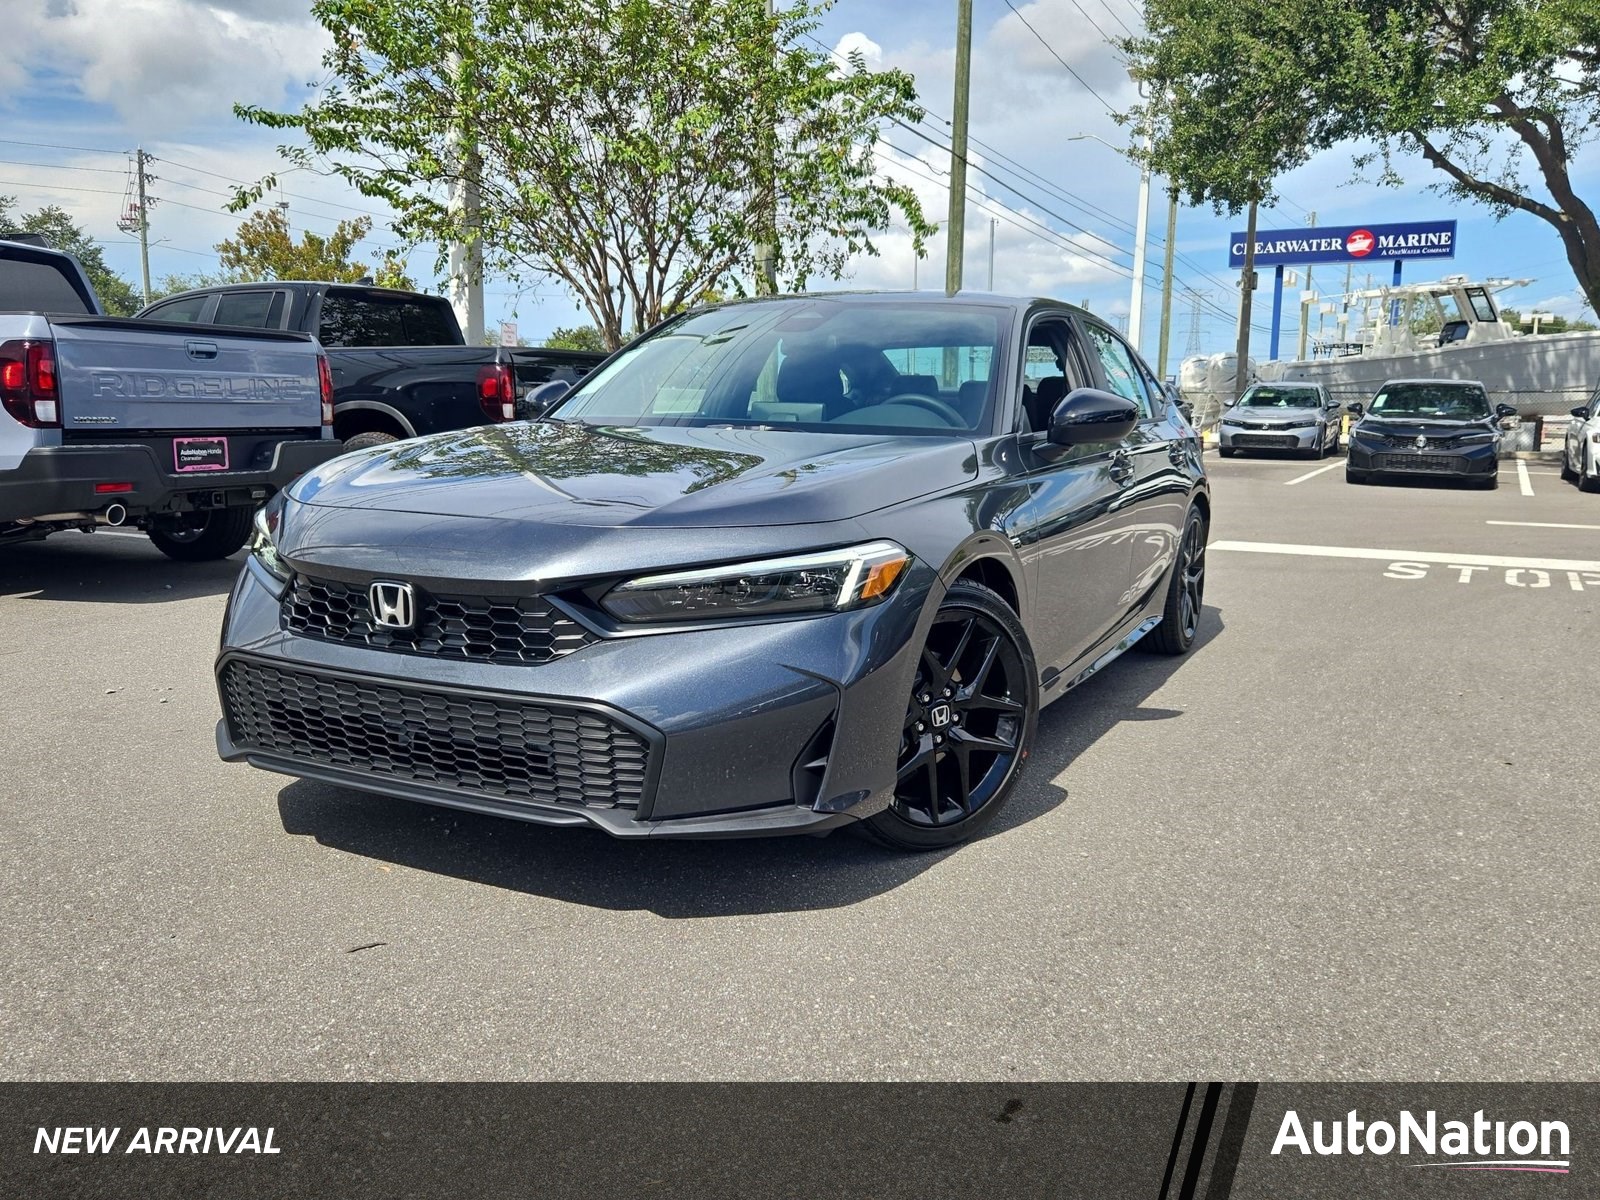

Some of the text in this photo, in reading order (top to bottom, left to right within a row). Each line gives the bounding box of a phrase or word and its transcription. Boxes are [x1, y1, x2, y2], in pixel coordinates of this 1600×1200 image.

[1378, 232, 1452, 248] MARINE
[92, 372, 302, 400] RIDGELINE
[73, 416, 119, 424] HONDA
[1383, 562, 1600, 591] STOP
